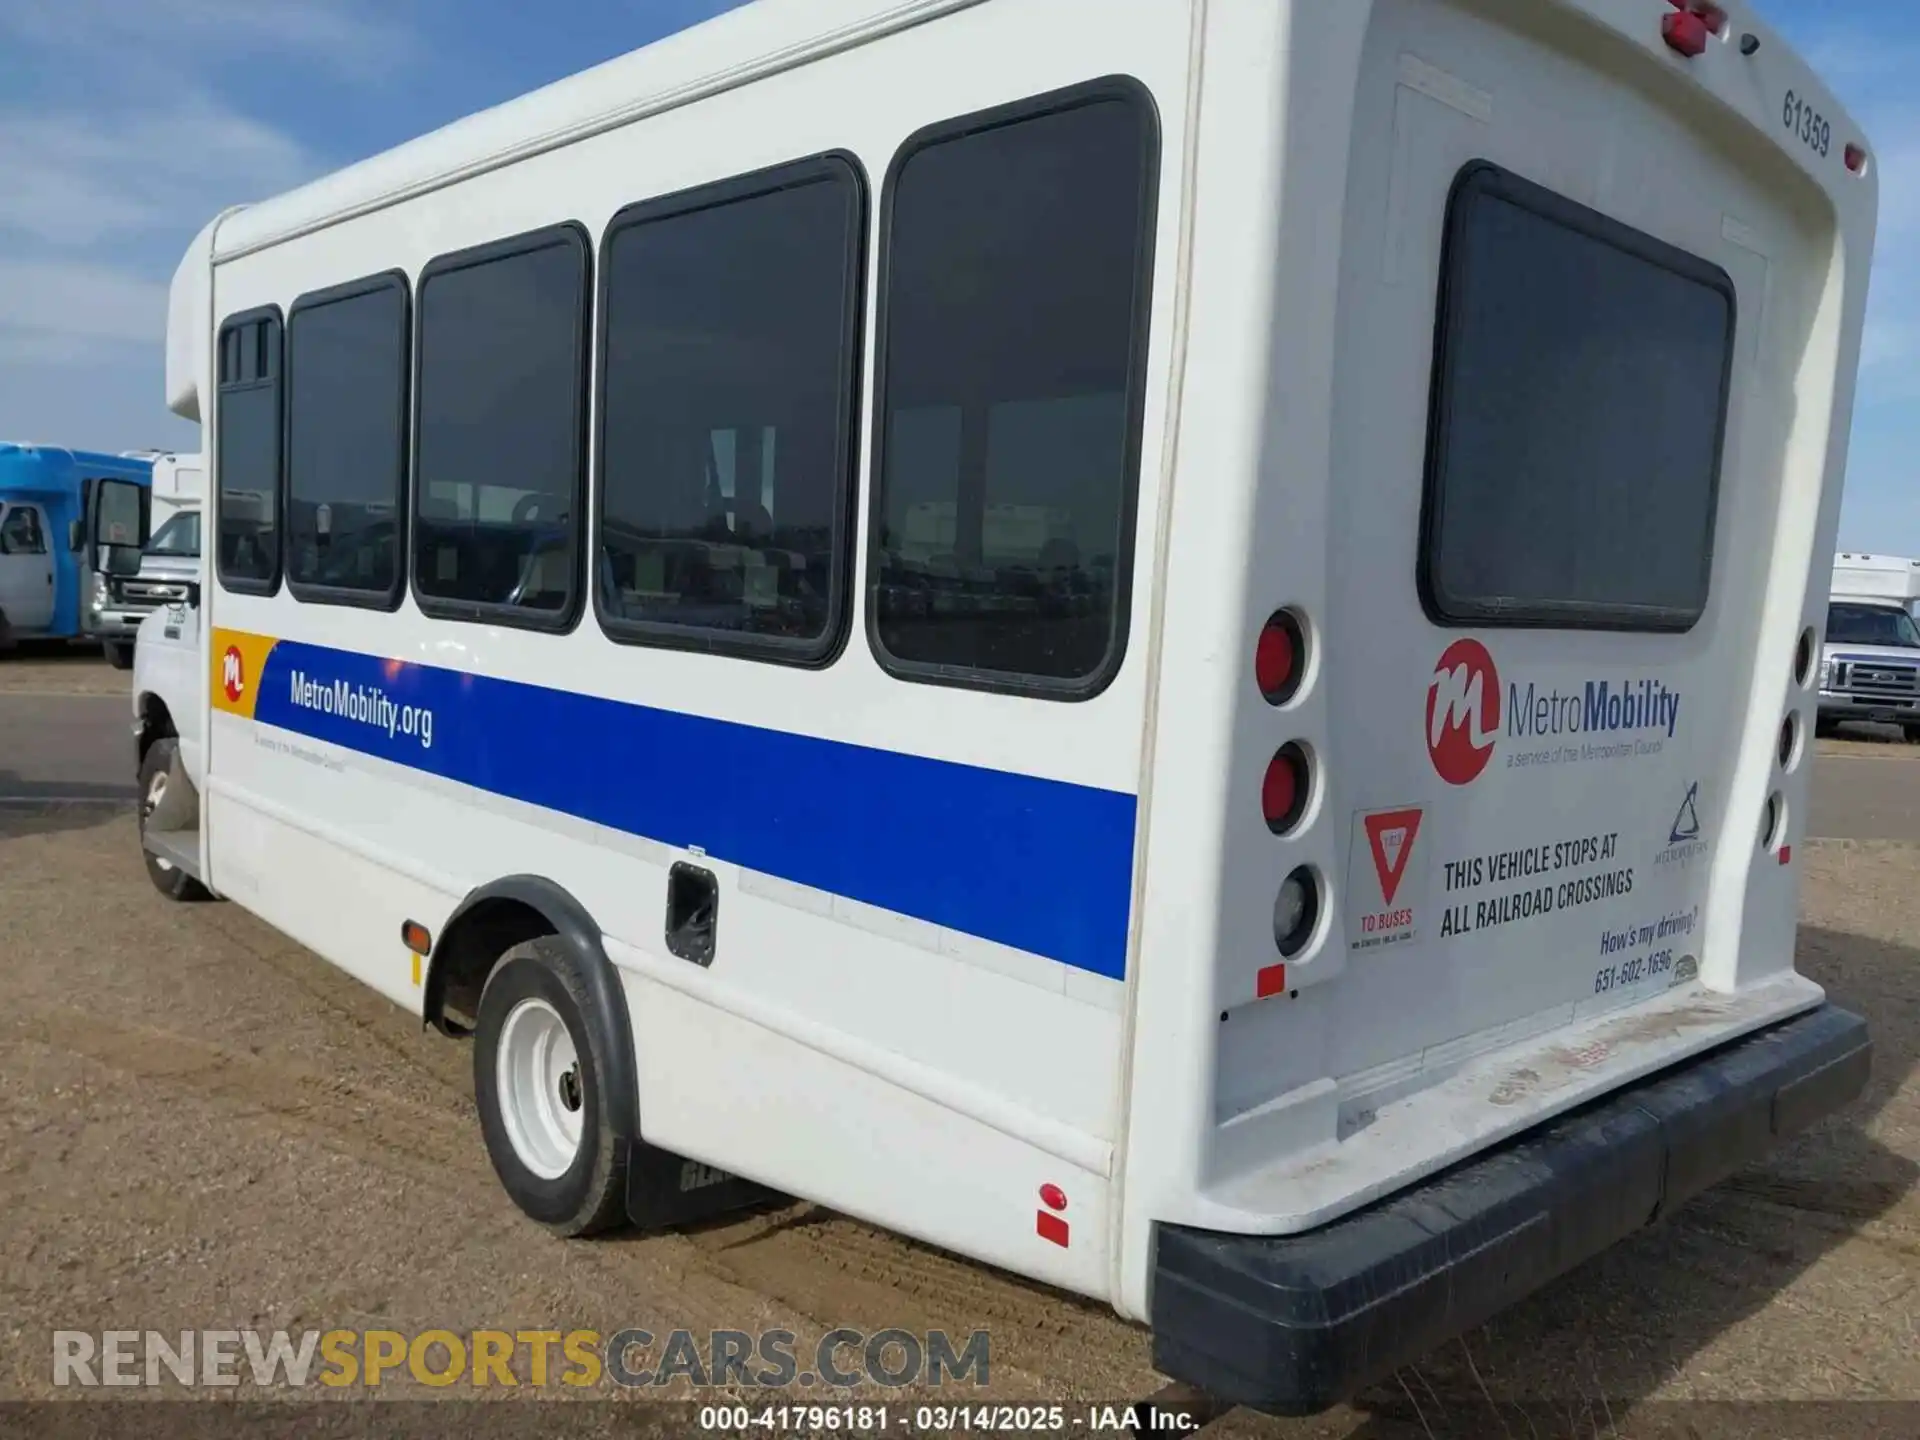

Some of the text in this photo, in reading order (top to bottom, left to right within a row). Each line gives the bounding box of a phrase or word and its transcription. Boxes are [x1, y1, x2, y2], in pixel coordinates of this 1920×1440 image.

[1782, 88, 1830, 158] 61359
[290, 669, 433, 748] MetroMobility.org
[1507, 679, 1680, 738] MetroMobility
[1444, 833, 1618, 891] THIS VEHICLE STOPS AT
[1361, 908, 1413, 932] TO BUSES
[1440, 905, 1471, 938] ALL
[1476, 887, 1553, 930] RAILROAD
[1557, 868, 1634, 910] CROSSINGS
[1600, 904, 1698, 956] How's my driving?
[1594, 948, 1673, 993] 651-602-1696
